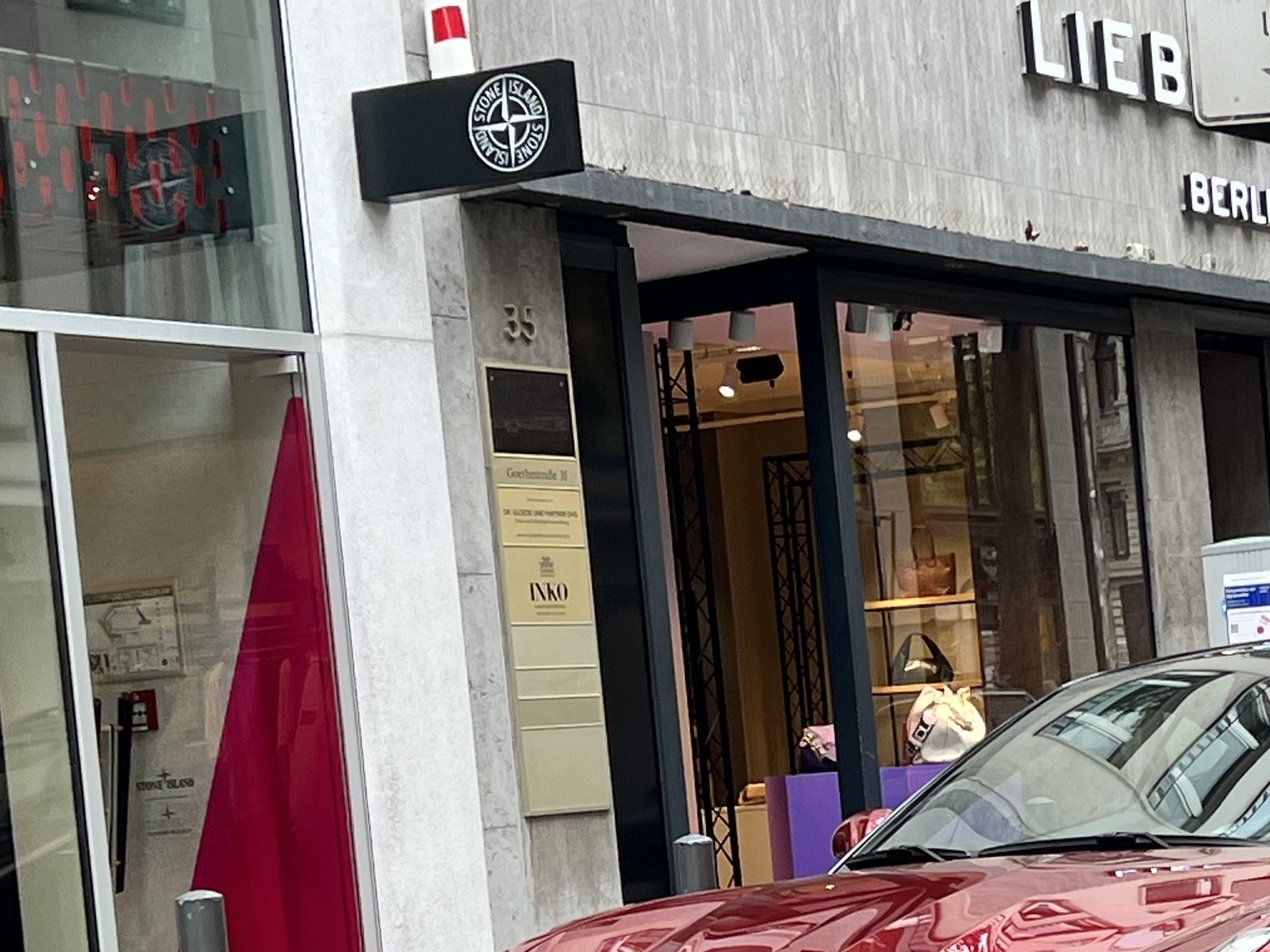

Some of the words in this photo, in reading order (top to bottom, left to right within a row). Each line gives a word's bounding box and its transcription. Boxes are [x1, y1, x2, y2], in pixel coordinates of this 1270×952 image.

[474, 82, 502, 123] STONE
[508, 79, 542, 116] ISLAND
[474, 130, 509, 166] ISLAND
[515, 122, 545, 164] STONE
[503, 303, 537, 342] 35
[529, 582, 568, 602] INKO
